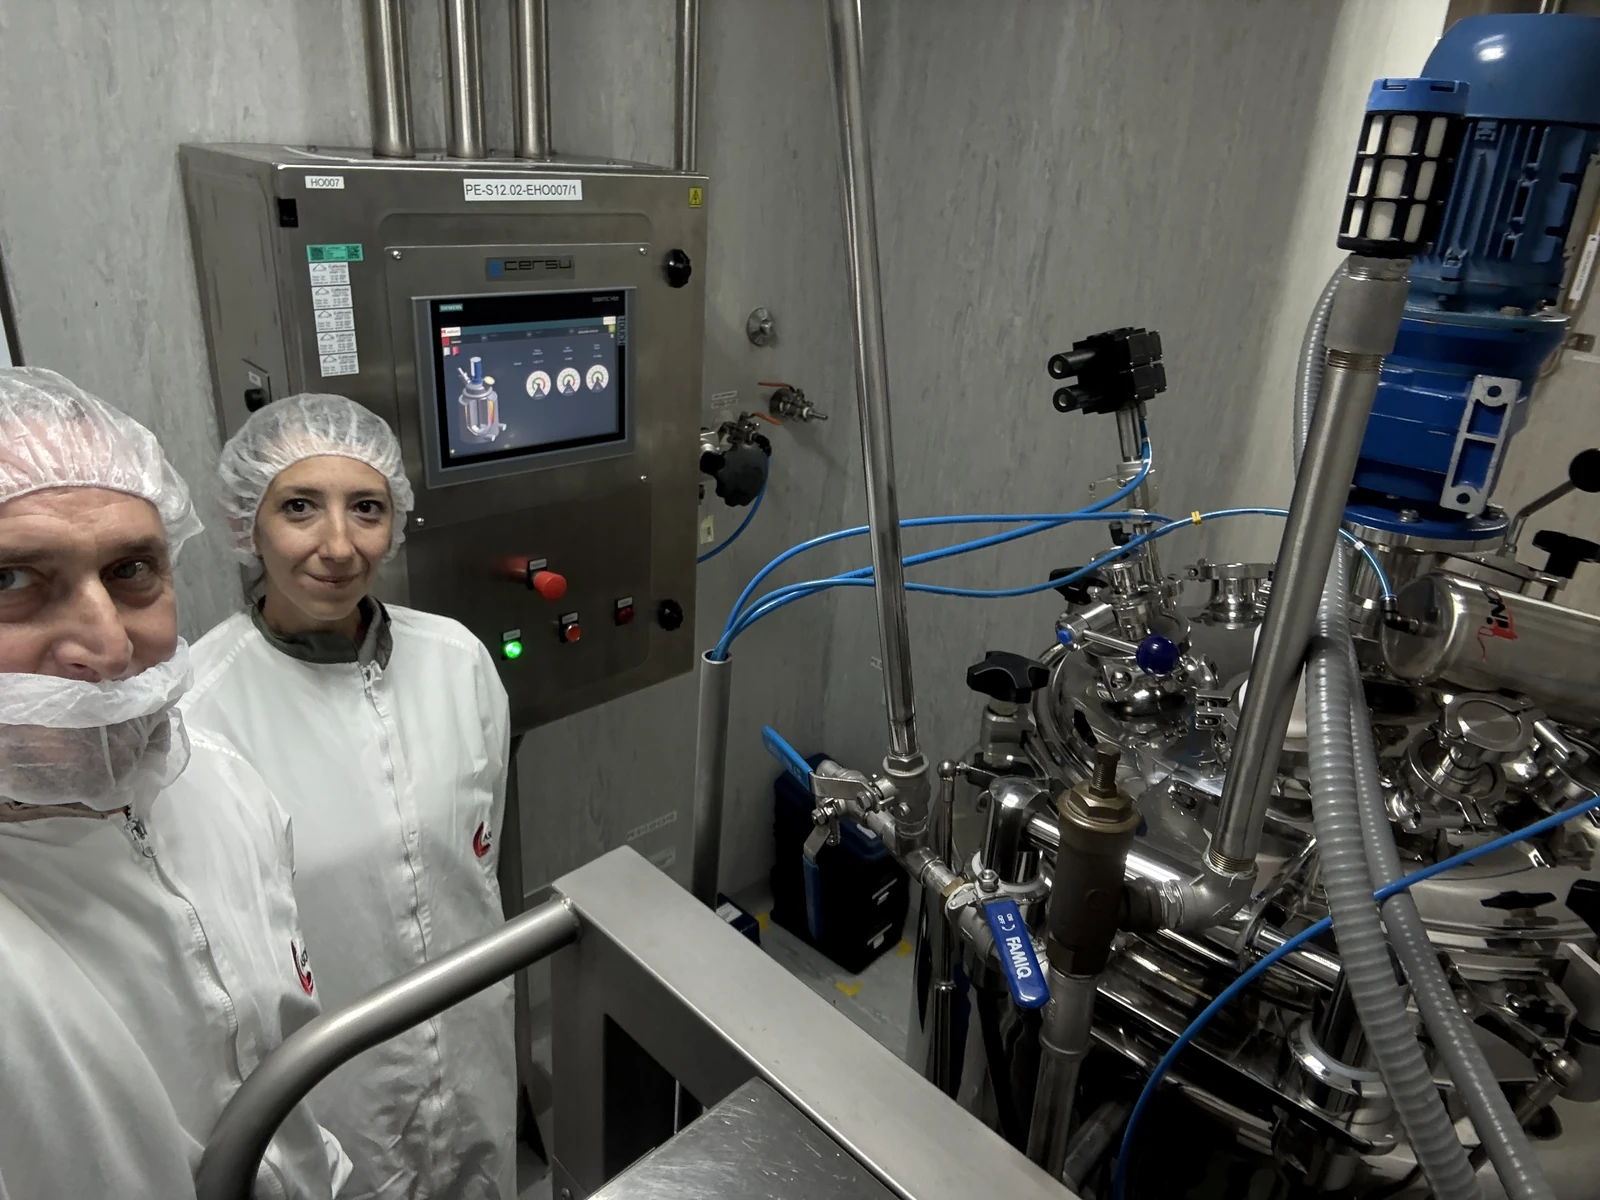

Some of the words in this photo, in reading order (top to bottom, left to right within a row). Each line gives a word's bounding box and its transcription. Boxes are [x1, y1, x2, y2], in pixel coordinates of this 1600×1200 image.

[310, 178, 340, 187] HO007
[465, 184, 577, 196] PE-S12.02-EHO007/1
[504, 259, 572, 271] cersu
[997, 914, 1006, 925] OFF
[1005, 936, 1032, 980] FAMIQ
